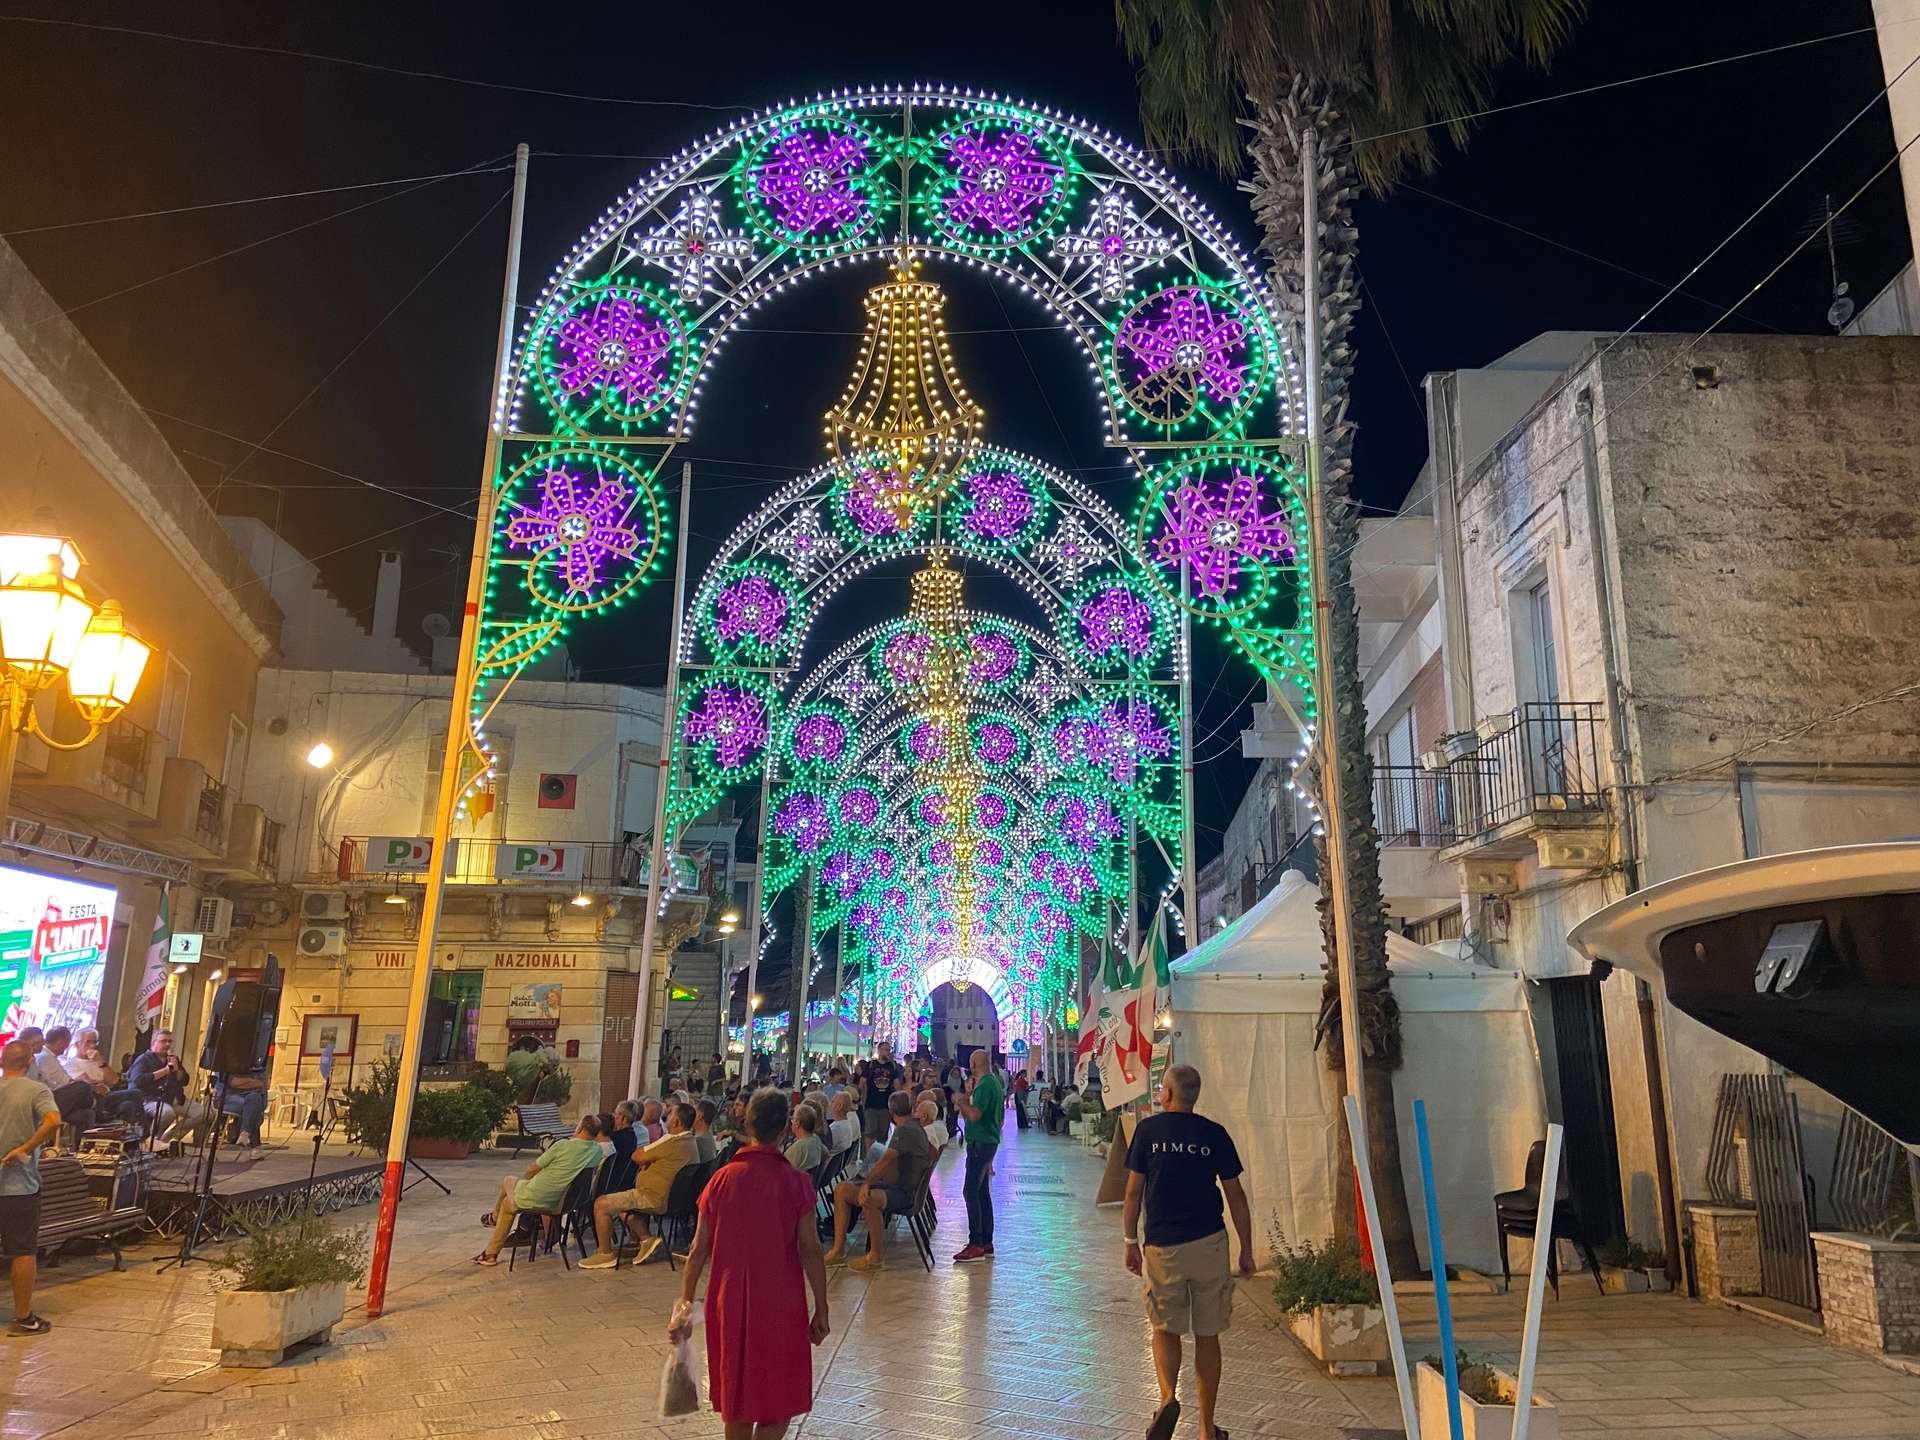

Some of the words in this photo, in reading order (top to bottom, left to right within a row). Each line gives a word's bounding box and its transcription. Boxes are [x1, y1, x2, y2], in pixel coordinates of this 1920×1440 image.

[516, 847, 558, 872] PD
[69, 904, 97, 918] FESTA
[375, 952, 406, 967] VINI
[495, 953, 577, 968] NAZIONALI
[1152, 1142, 1211, 1157] PIMCO
